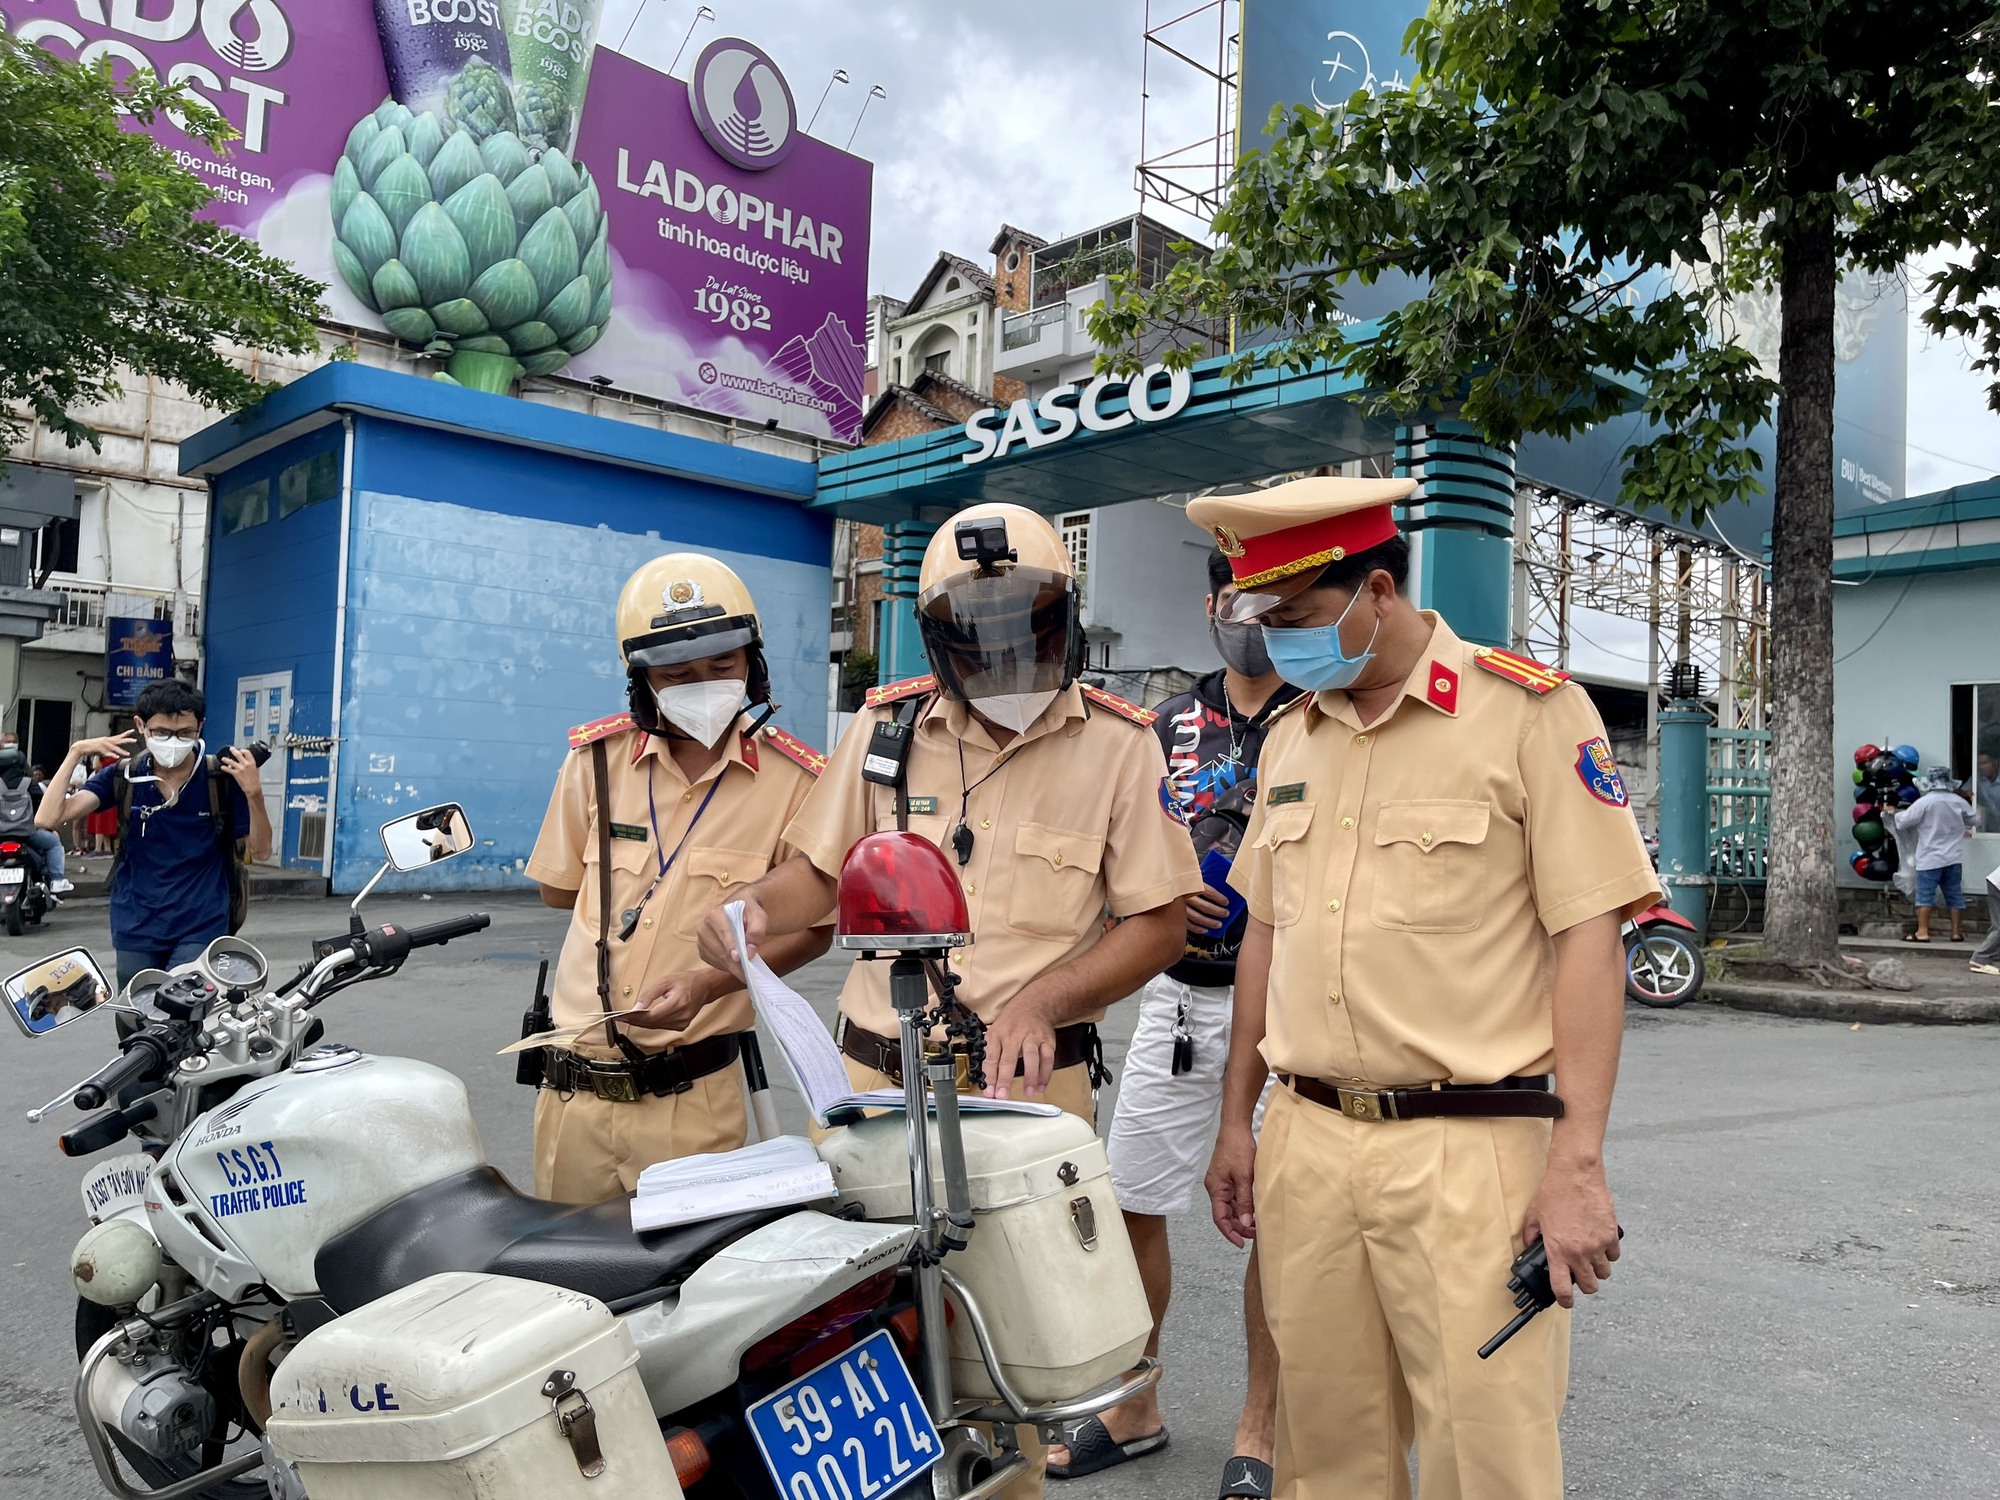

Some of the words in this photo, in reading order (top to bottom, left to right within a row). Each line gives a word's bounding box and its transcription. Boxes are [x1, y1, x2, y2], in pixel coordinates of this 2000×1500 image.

[453, 37, 489, 51] 1982
[540, 58, 568, 79] 1982
[204, 161, 238, 180] mát
[240, 171, 275, 193] gan,
[617, 147, 844, 265] LADOPHAR
[696, 228, 731, 259] hoa
[733, 243, 780, 275] dược
[781, 256, 810, 285] liệu
[693, 287, 772, 332] 1982
[719, 372, 837, 414] www.ladophar.com
[961, 363, 1192, 465] SASCO
[195, 1123, 243, 1148] HONDA
[216, 1140, 283, 1188] C.S.G.T
[210, 1188, 261, 1218] TRAFFIC
[262, 1180, 307, 1210] POLICE
[856, 1242, 906, 1271] HONDA
[772, 1349, 890, 1456] 59-A1
